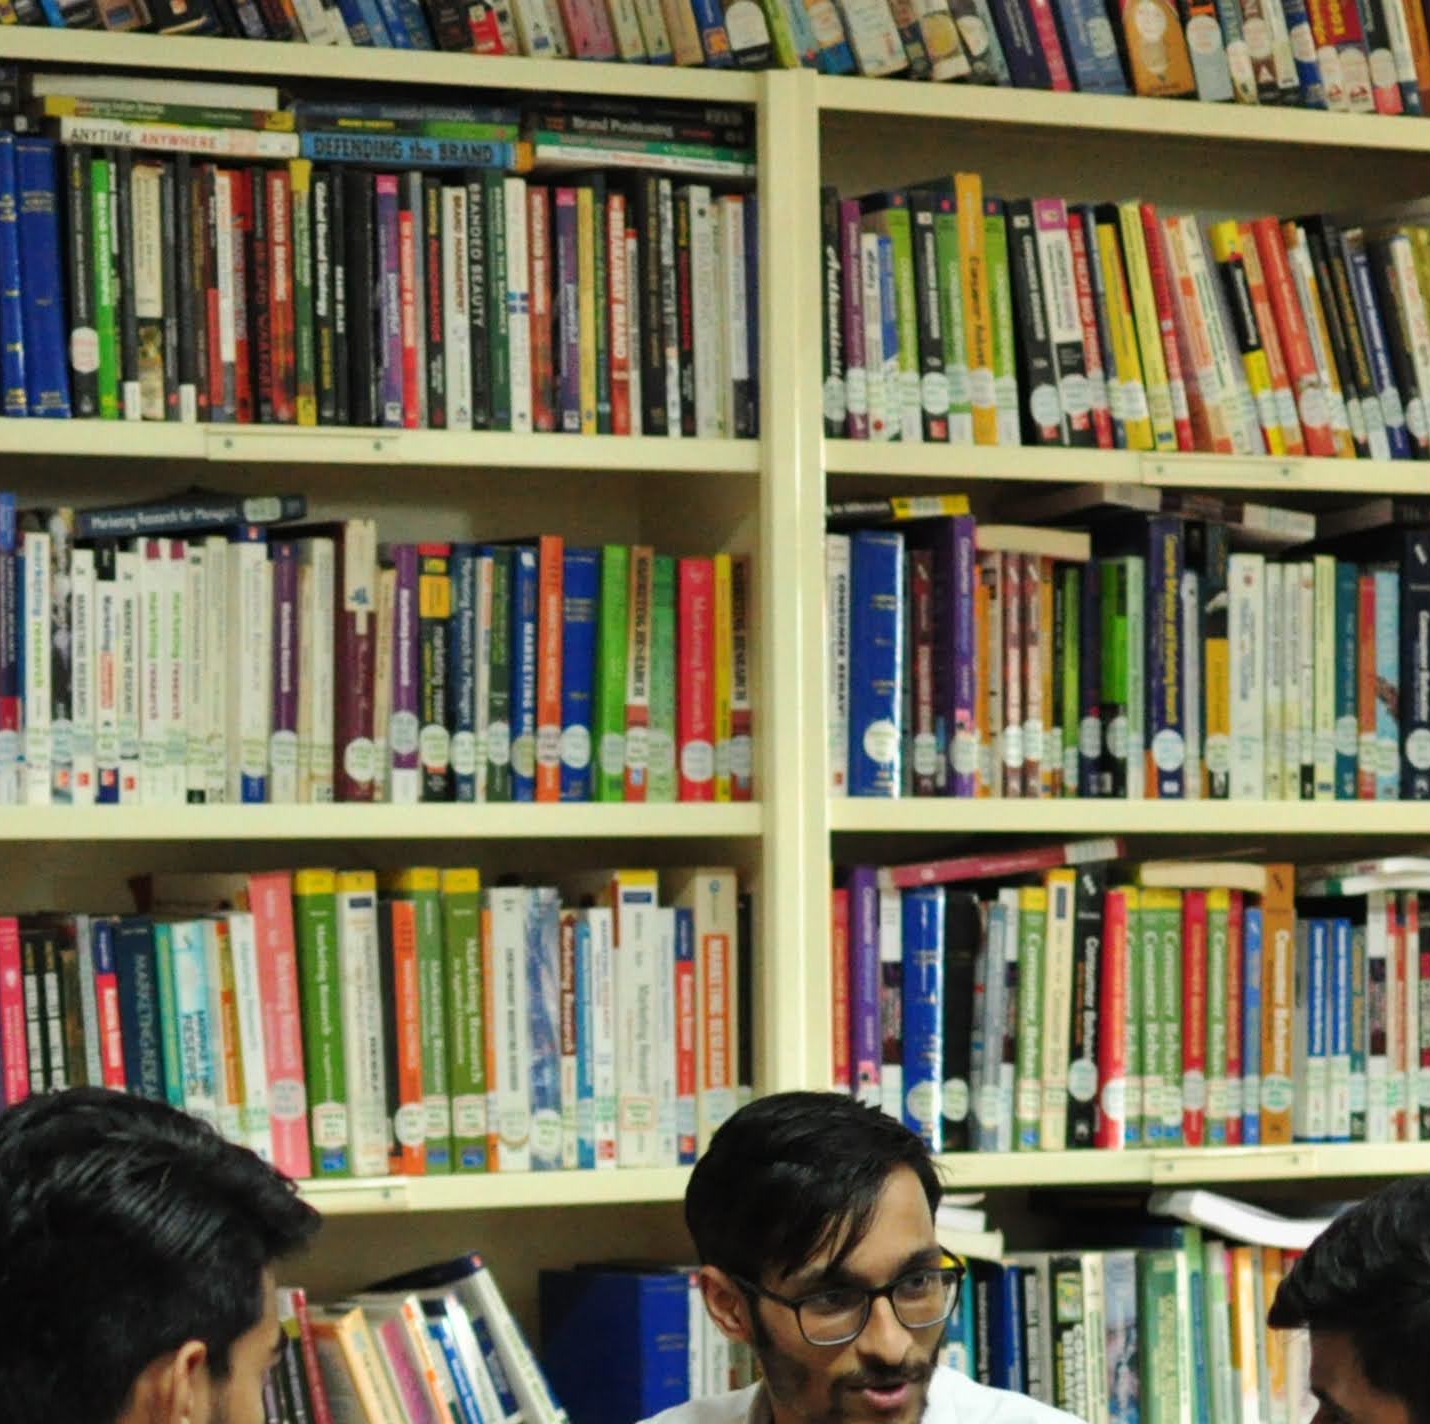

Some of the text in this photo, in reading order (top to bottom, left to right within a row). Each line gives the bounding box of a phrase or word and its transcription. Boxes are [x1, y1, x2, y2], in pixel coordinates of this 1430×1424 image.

[140, 132, 217, 151] ANYWHERE
[313, 136, 495, 163] DEFENDING the BRAND
[315, 182, 327, 221] Global
[317, 224, 328, 259] Brand
[469, 183, 484, 328] BRANDED BEAUTY
